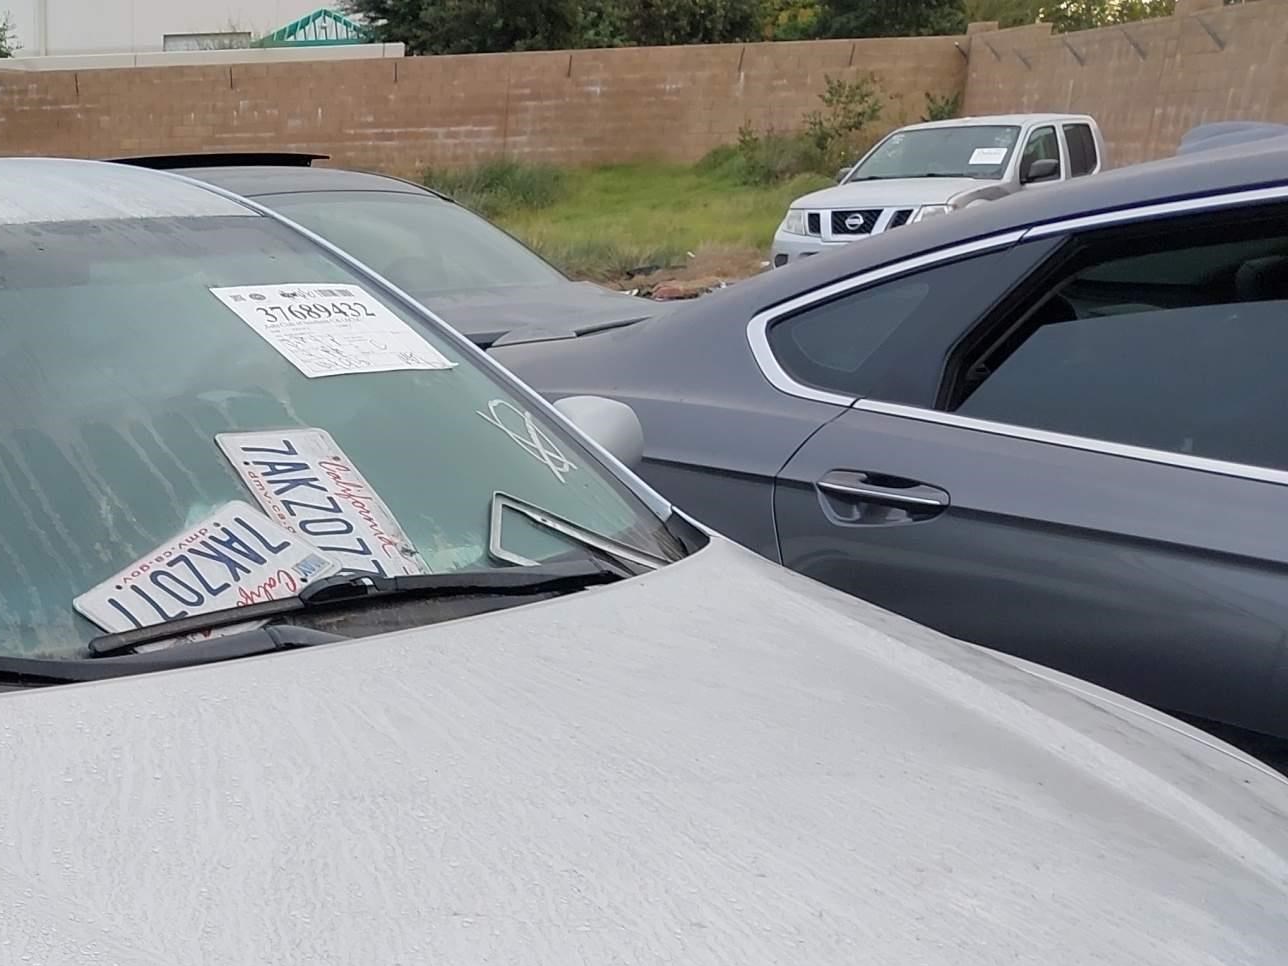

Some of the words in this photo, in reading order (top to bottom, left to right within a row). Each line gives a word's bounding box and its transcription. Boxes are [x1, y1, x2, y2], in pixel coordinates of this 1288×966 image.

[256, 301, 376, 323] 37689432
[240, 439, 388, 577] 7AKZ077
[318, 460, 392, 559] California
[122, 527, 209, 585] dmv.ca.gov
